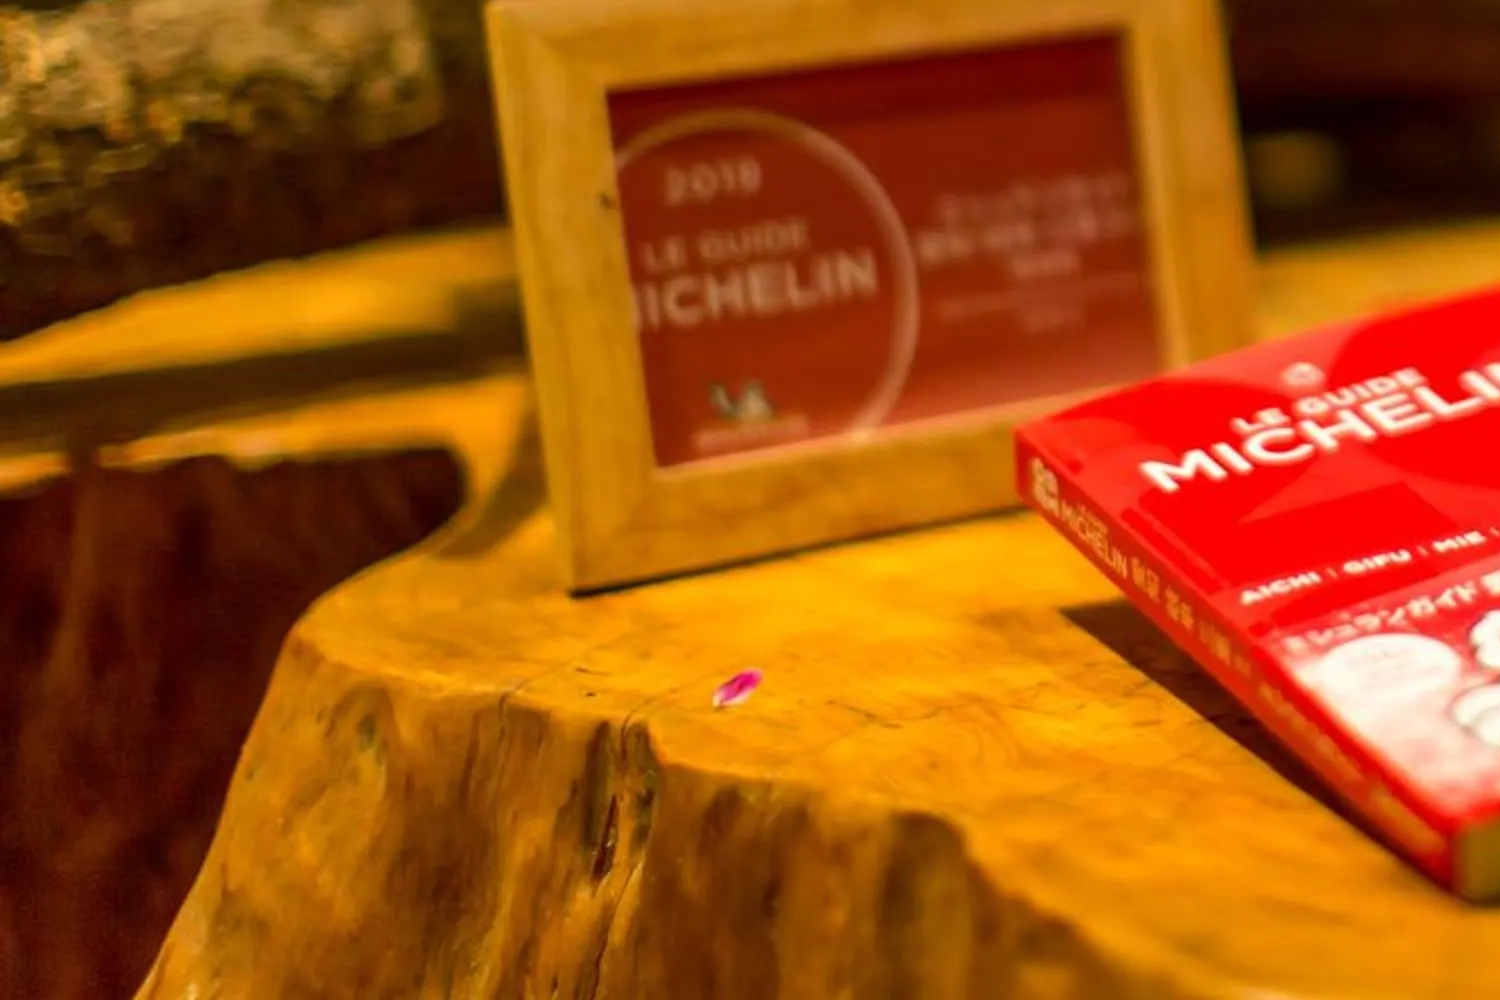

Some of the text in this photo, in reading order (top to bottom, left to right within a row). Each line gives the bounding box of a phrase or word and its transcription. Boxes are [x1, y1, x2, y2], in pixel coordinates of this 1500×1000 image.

[642, 218, 808, 272] LE GUIDE
[632, 249, 876, 332] ICHELIN
[1231, 368, 1425, 433] LE GUIDE
[1241, 572, 1321, 605] AICHI
[1343, 549, 1412, 573] GIFU
[1432, 531, 1486, 552] MIE
